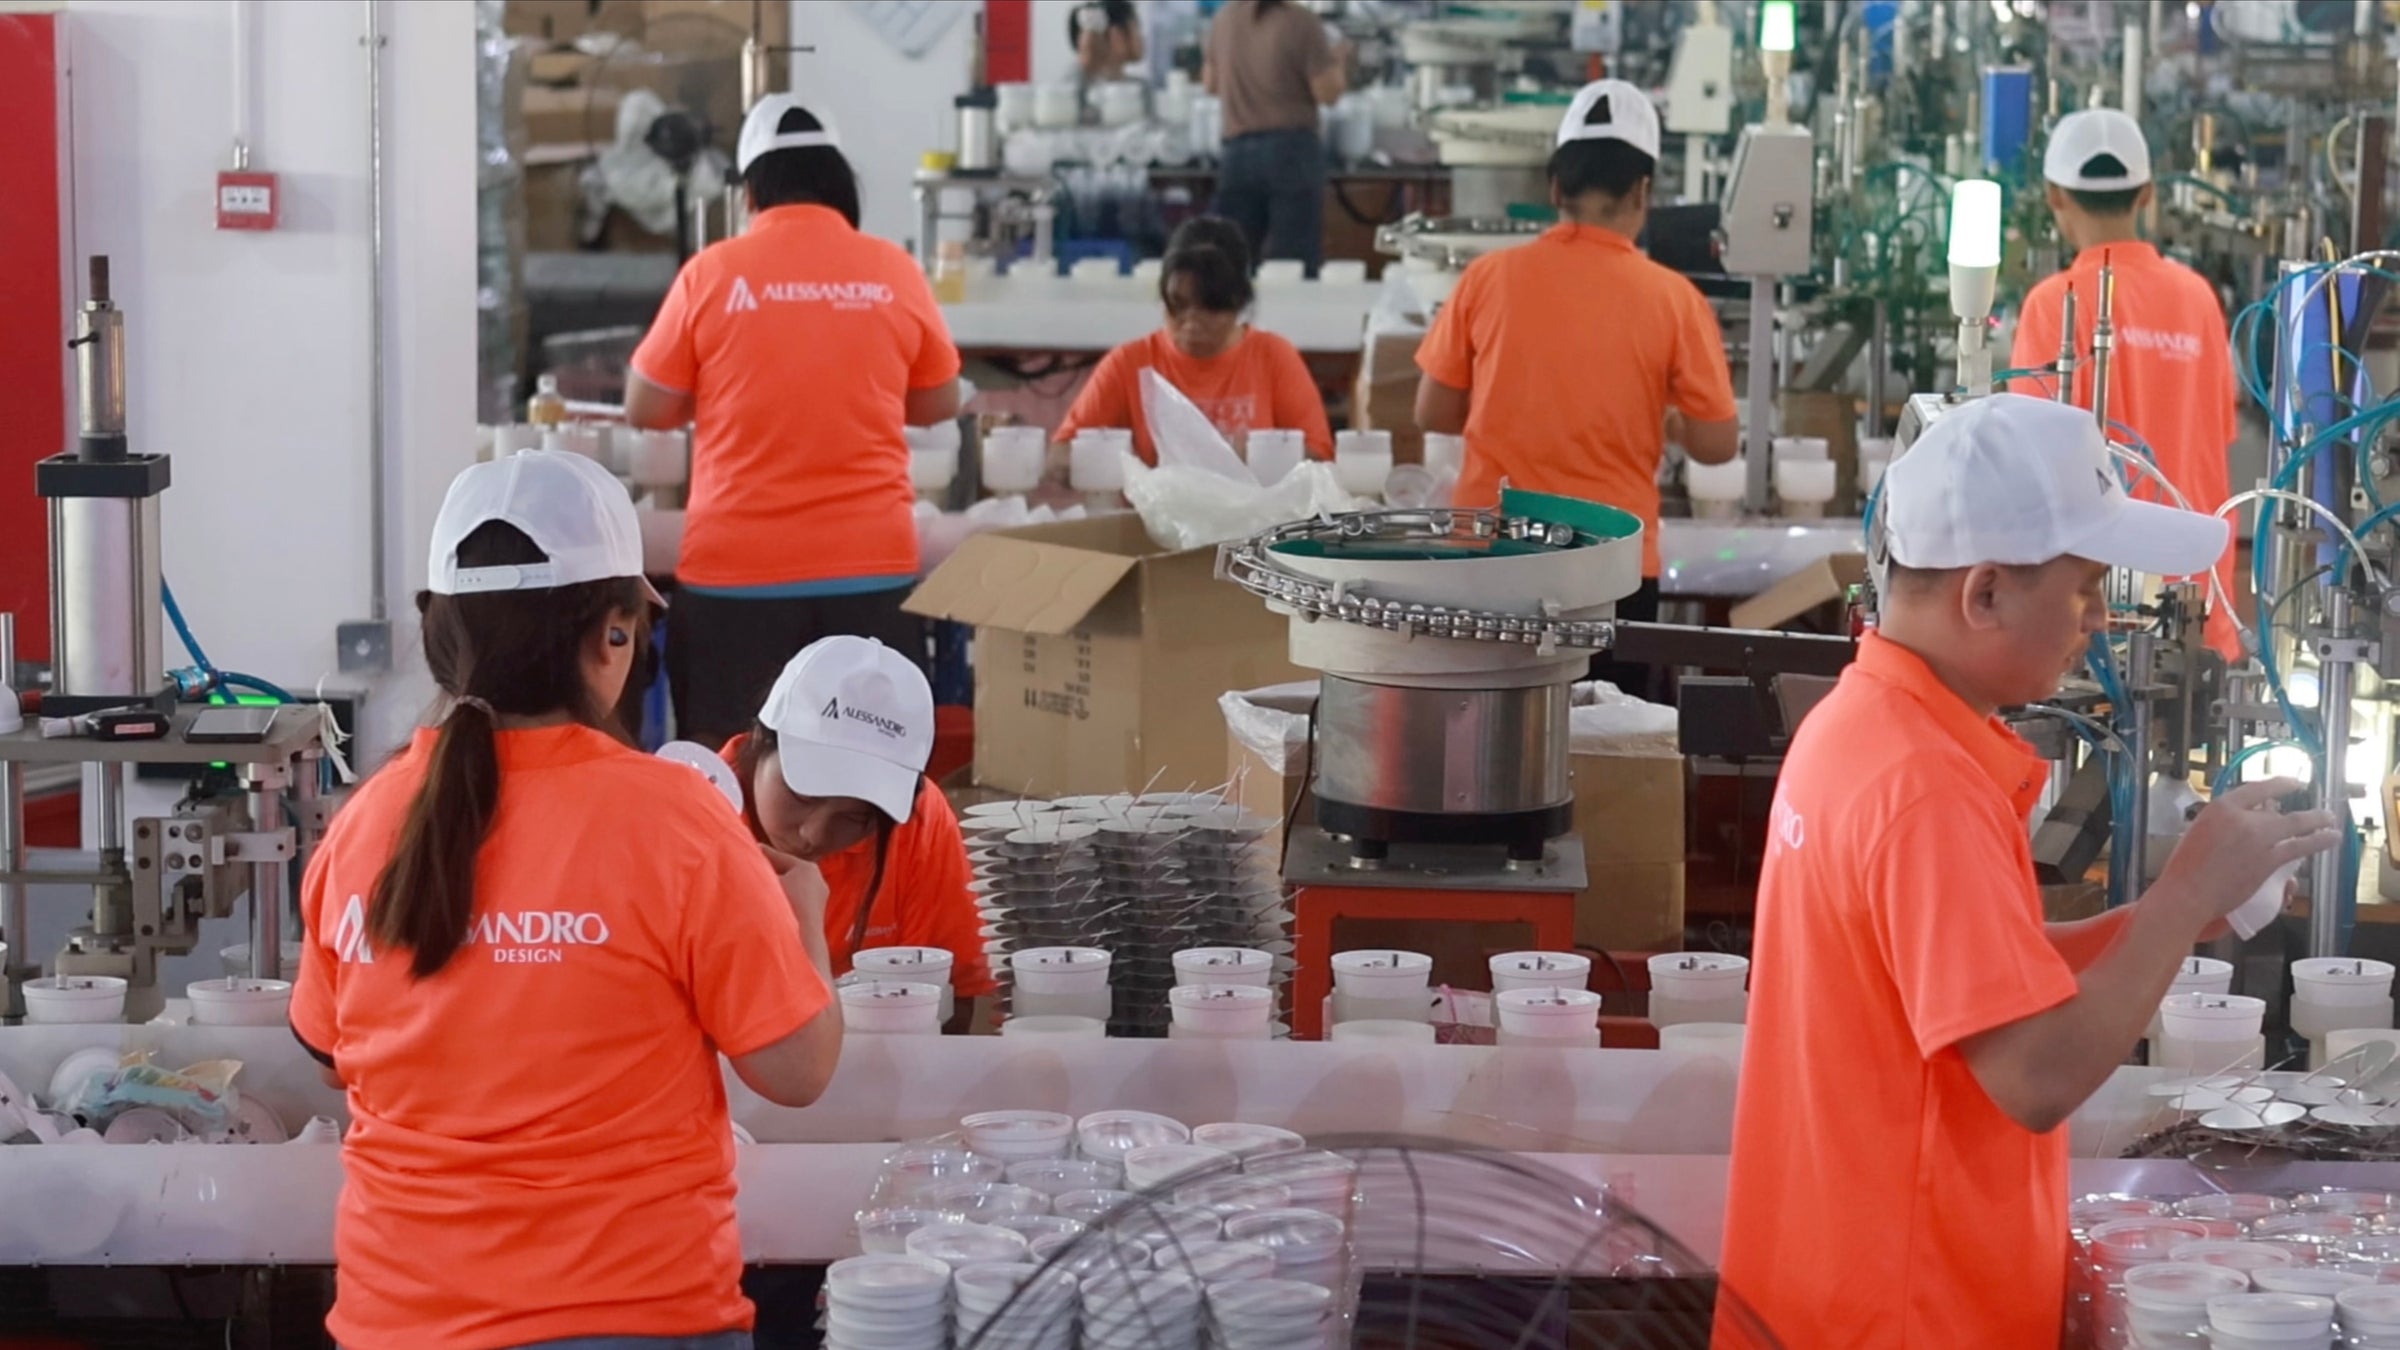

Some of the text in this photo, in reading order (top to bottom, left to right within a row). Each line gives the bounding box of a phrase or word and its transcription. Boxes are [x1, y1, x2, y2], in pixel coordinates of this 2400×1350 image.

[762, 283, 894, 304] ALESSANDRO
[843, 707, 906, 737] ALESSANDRO
[494, 949, 562, 963] DESIGN
